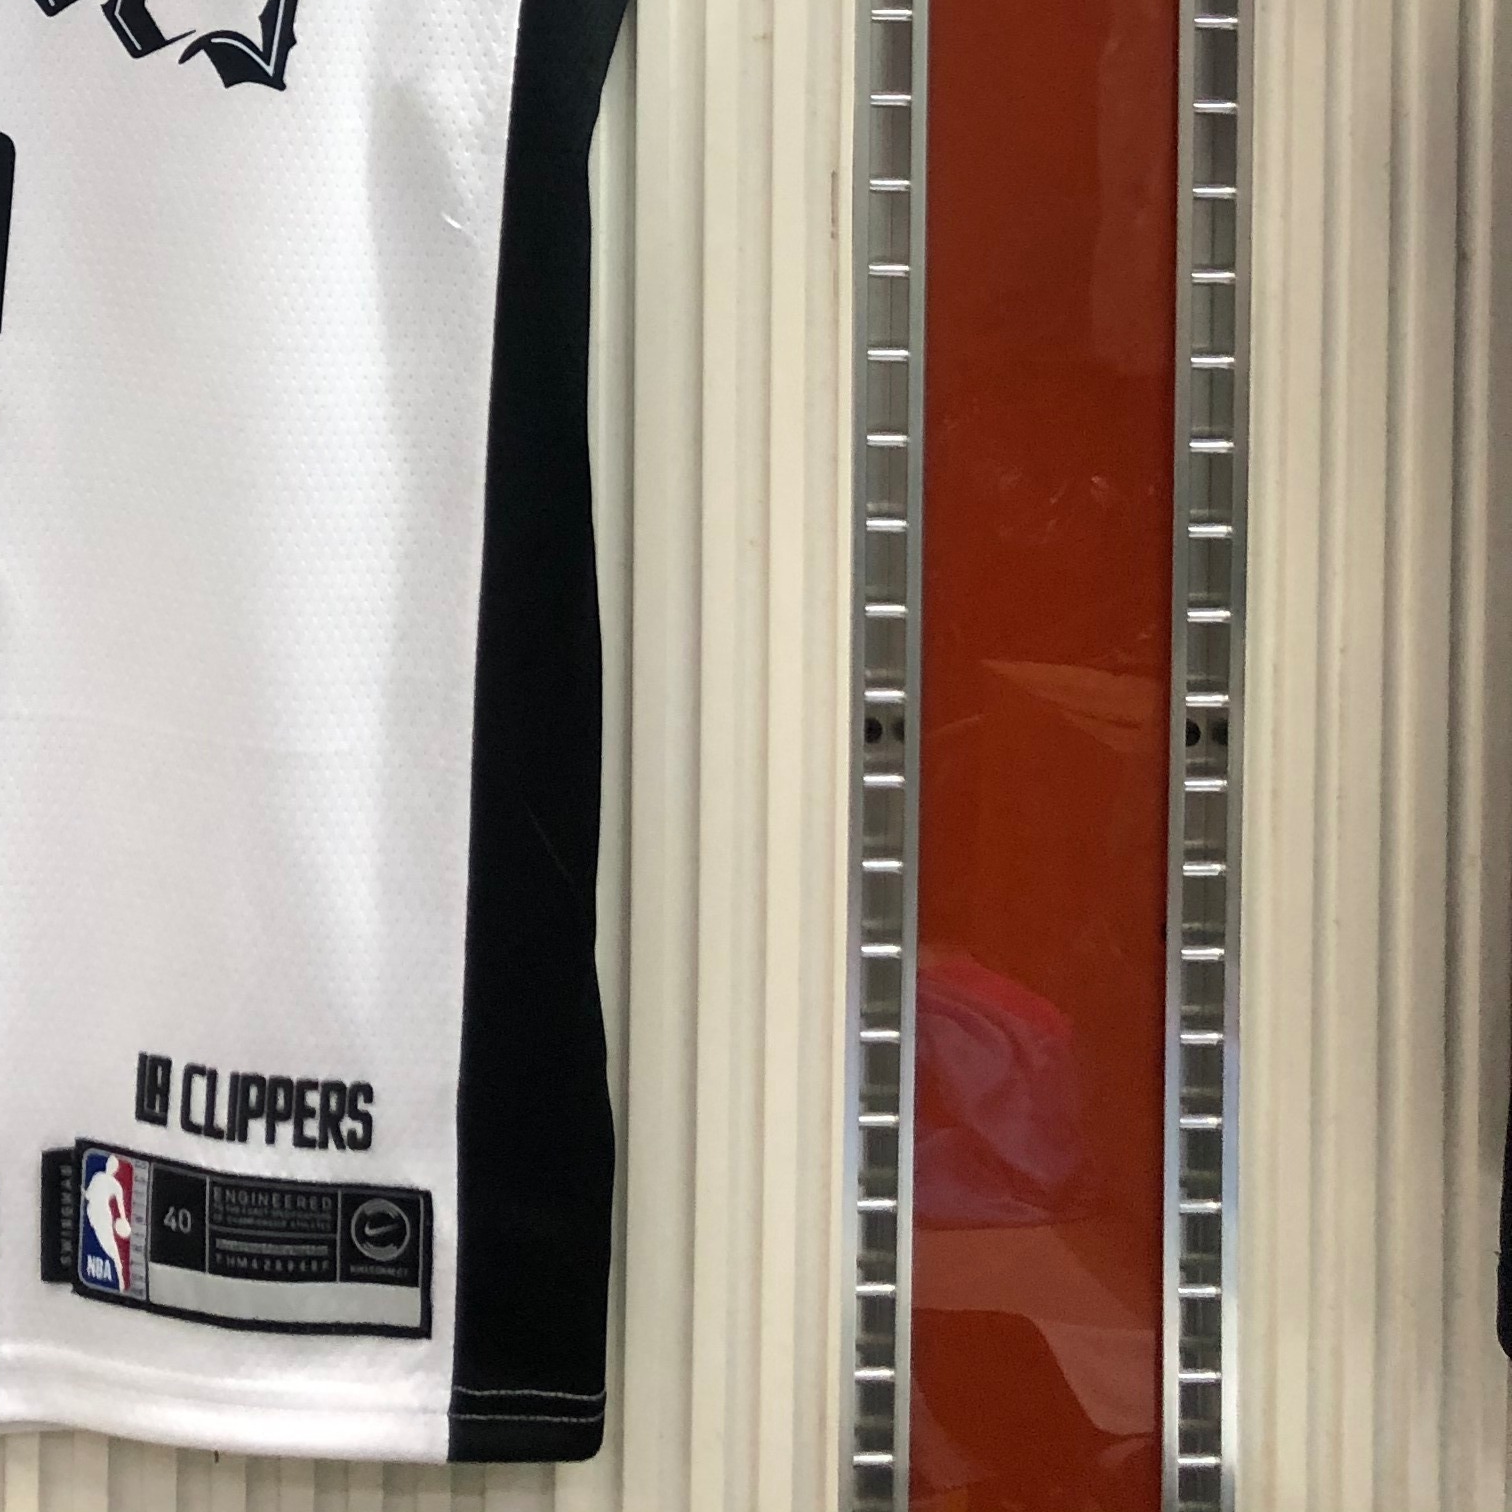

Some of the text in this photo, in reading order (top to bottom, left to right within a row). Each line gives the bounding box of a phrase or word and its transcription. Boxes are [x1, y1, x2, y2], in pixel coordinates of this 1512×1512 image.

[180, 1062, 375, 1151] CLIPPERS
[213, 1185, 332, 1210] ENGINEERED
[163, 1206, 192, 1234] 40
[86, 1254, 113, 1282] NBA
